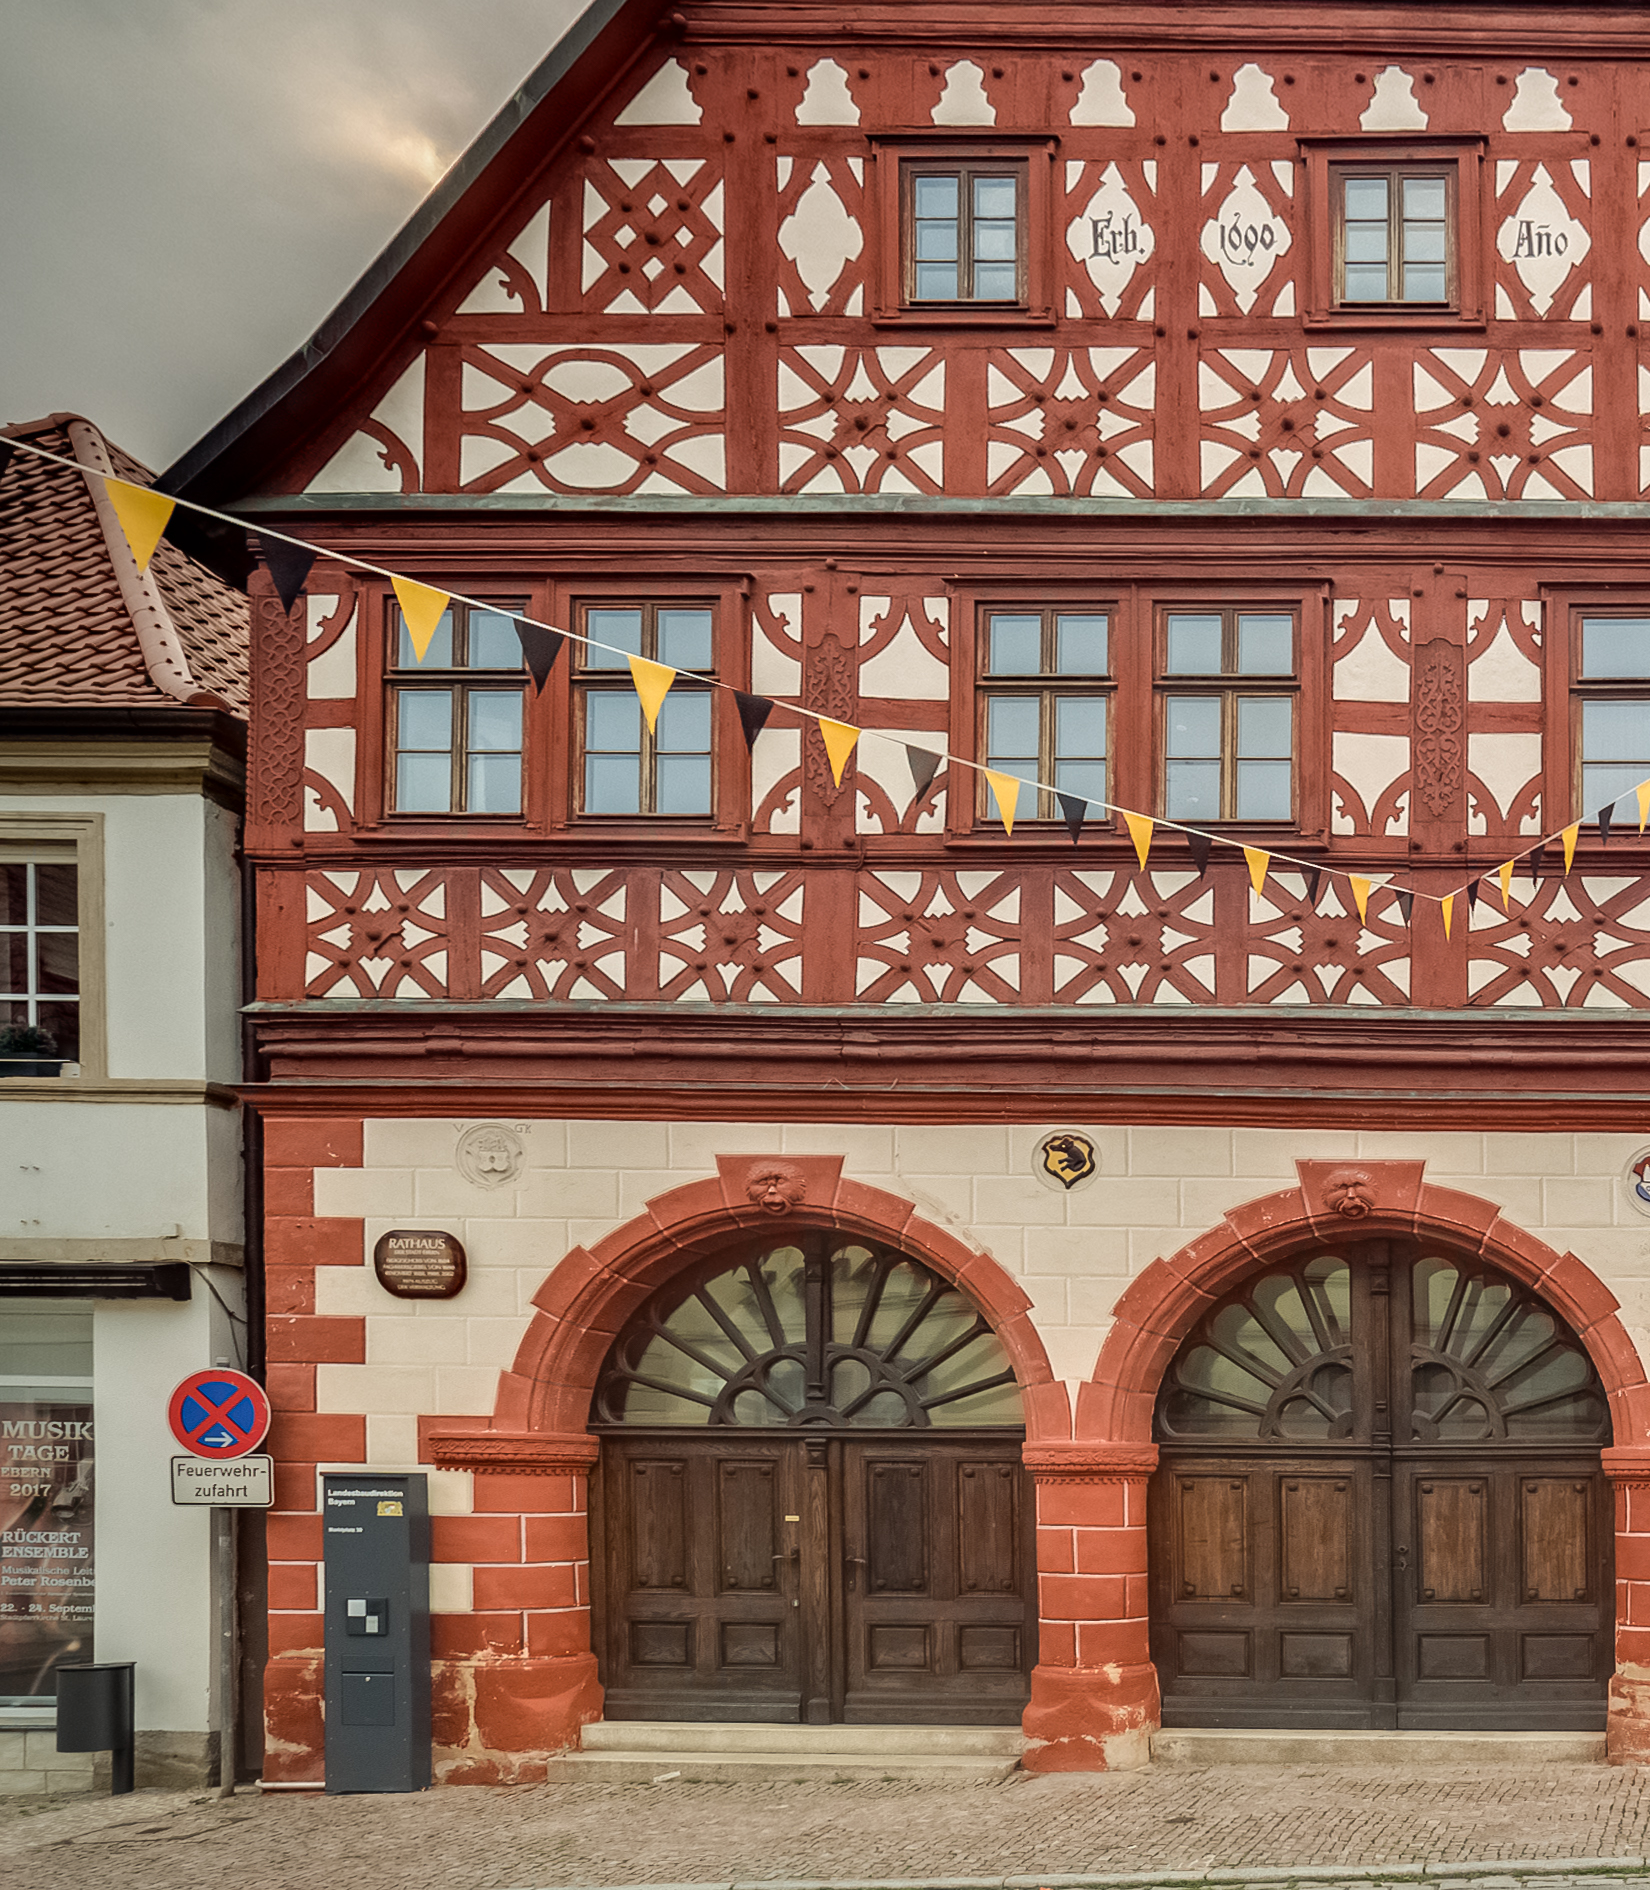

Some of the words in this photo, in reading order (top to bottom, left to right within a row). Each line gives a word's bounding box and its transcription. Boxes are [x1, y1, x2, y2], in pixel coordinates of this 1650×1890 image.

[388, 1238, 446, 1249] RATHAUS
[1, 1420, 94, 1440] MUSIK
[7, 1445, 69, 1461] TAGE
[0, 1467, 51, 1477] EBERN
[177, 1463, 267, 1477] Feuerwehr-
[10, 1483, 51, 1497] 2017
[195, 1484, 248, 1497] zufahrt
[2, 1528, 81, 1543] RÜCKERT
[2, 1546, 89, 1558] ENSEMBLE
[1, 1566, 70, 1575] Musikalische
[1, 1576, 37, 1586] Peter
[0, 1603, 18, 1612] 22.
